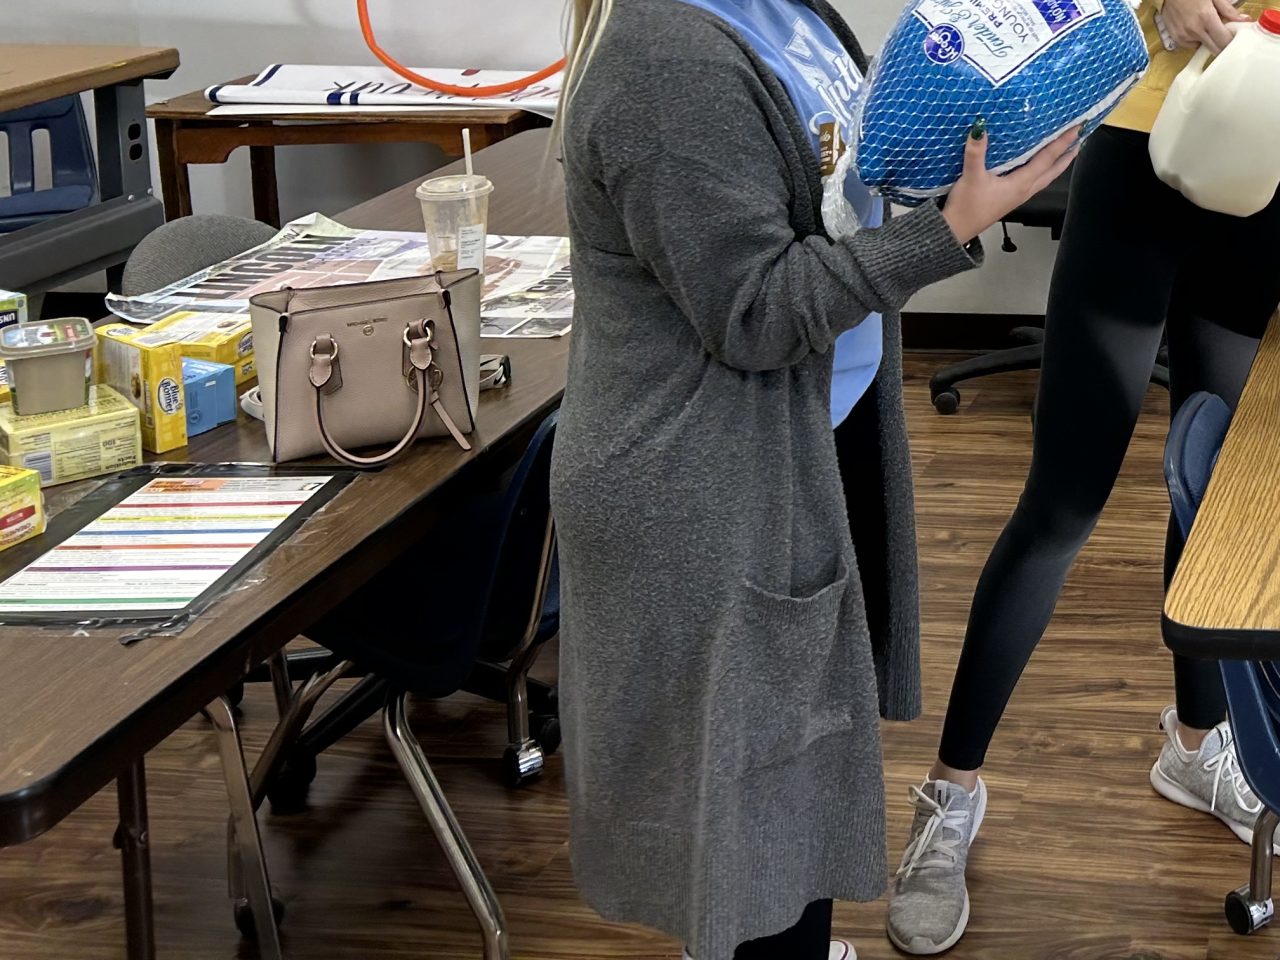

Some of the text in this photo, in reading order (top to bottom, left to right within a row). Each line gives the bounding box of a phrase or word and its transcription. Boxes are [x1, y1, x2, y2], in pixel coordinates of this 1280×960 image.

[928, 29, 959, 60] Kroger
[172, 233, 356, 299] LINCOLN
[0, 312, 16, 325] UNS
[161, 381, 174, 411] Bonnet
[170, 384, 180, 405] Blue
